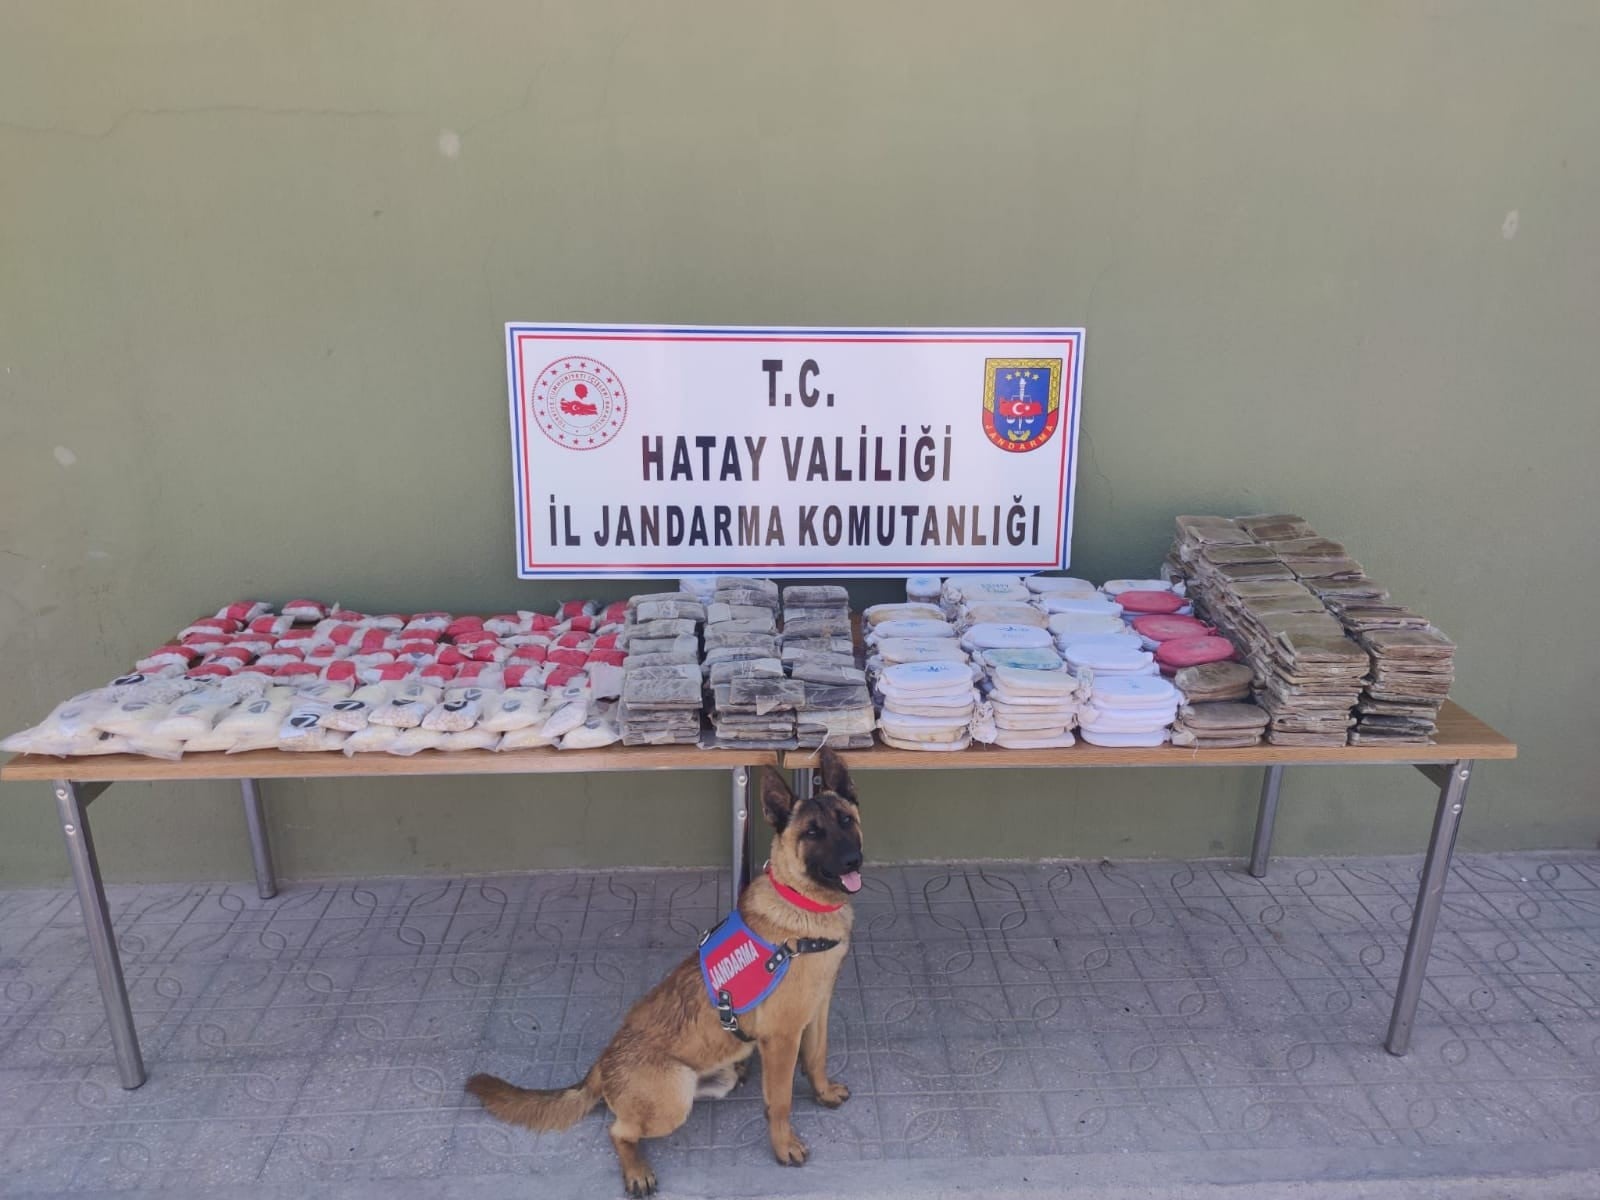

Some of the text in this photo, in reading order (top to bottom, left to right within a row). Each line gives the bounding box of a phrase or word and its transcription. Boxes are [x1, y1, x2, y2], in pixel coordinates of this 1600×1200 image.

[762, 359, 835, 408] T.C.
[642, 424, 952, 482] HATAY VALİLİĞİ
[985, 424, 1054, 450] JANDARMA
[549, 494, 1041, 547] İL JANDARMA KOMUTANLIĞI
[709, 939, 760, 991] JANDARMA
